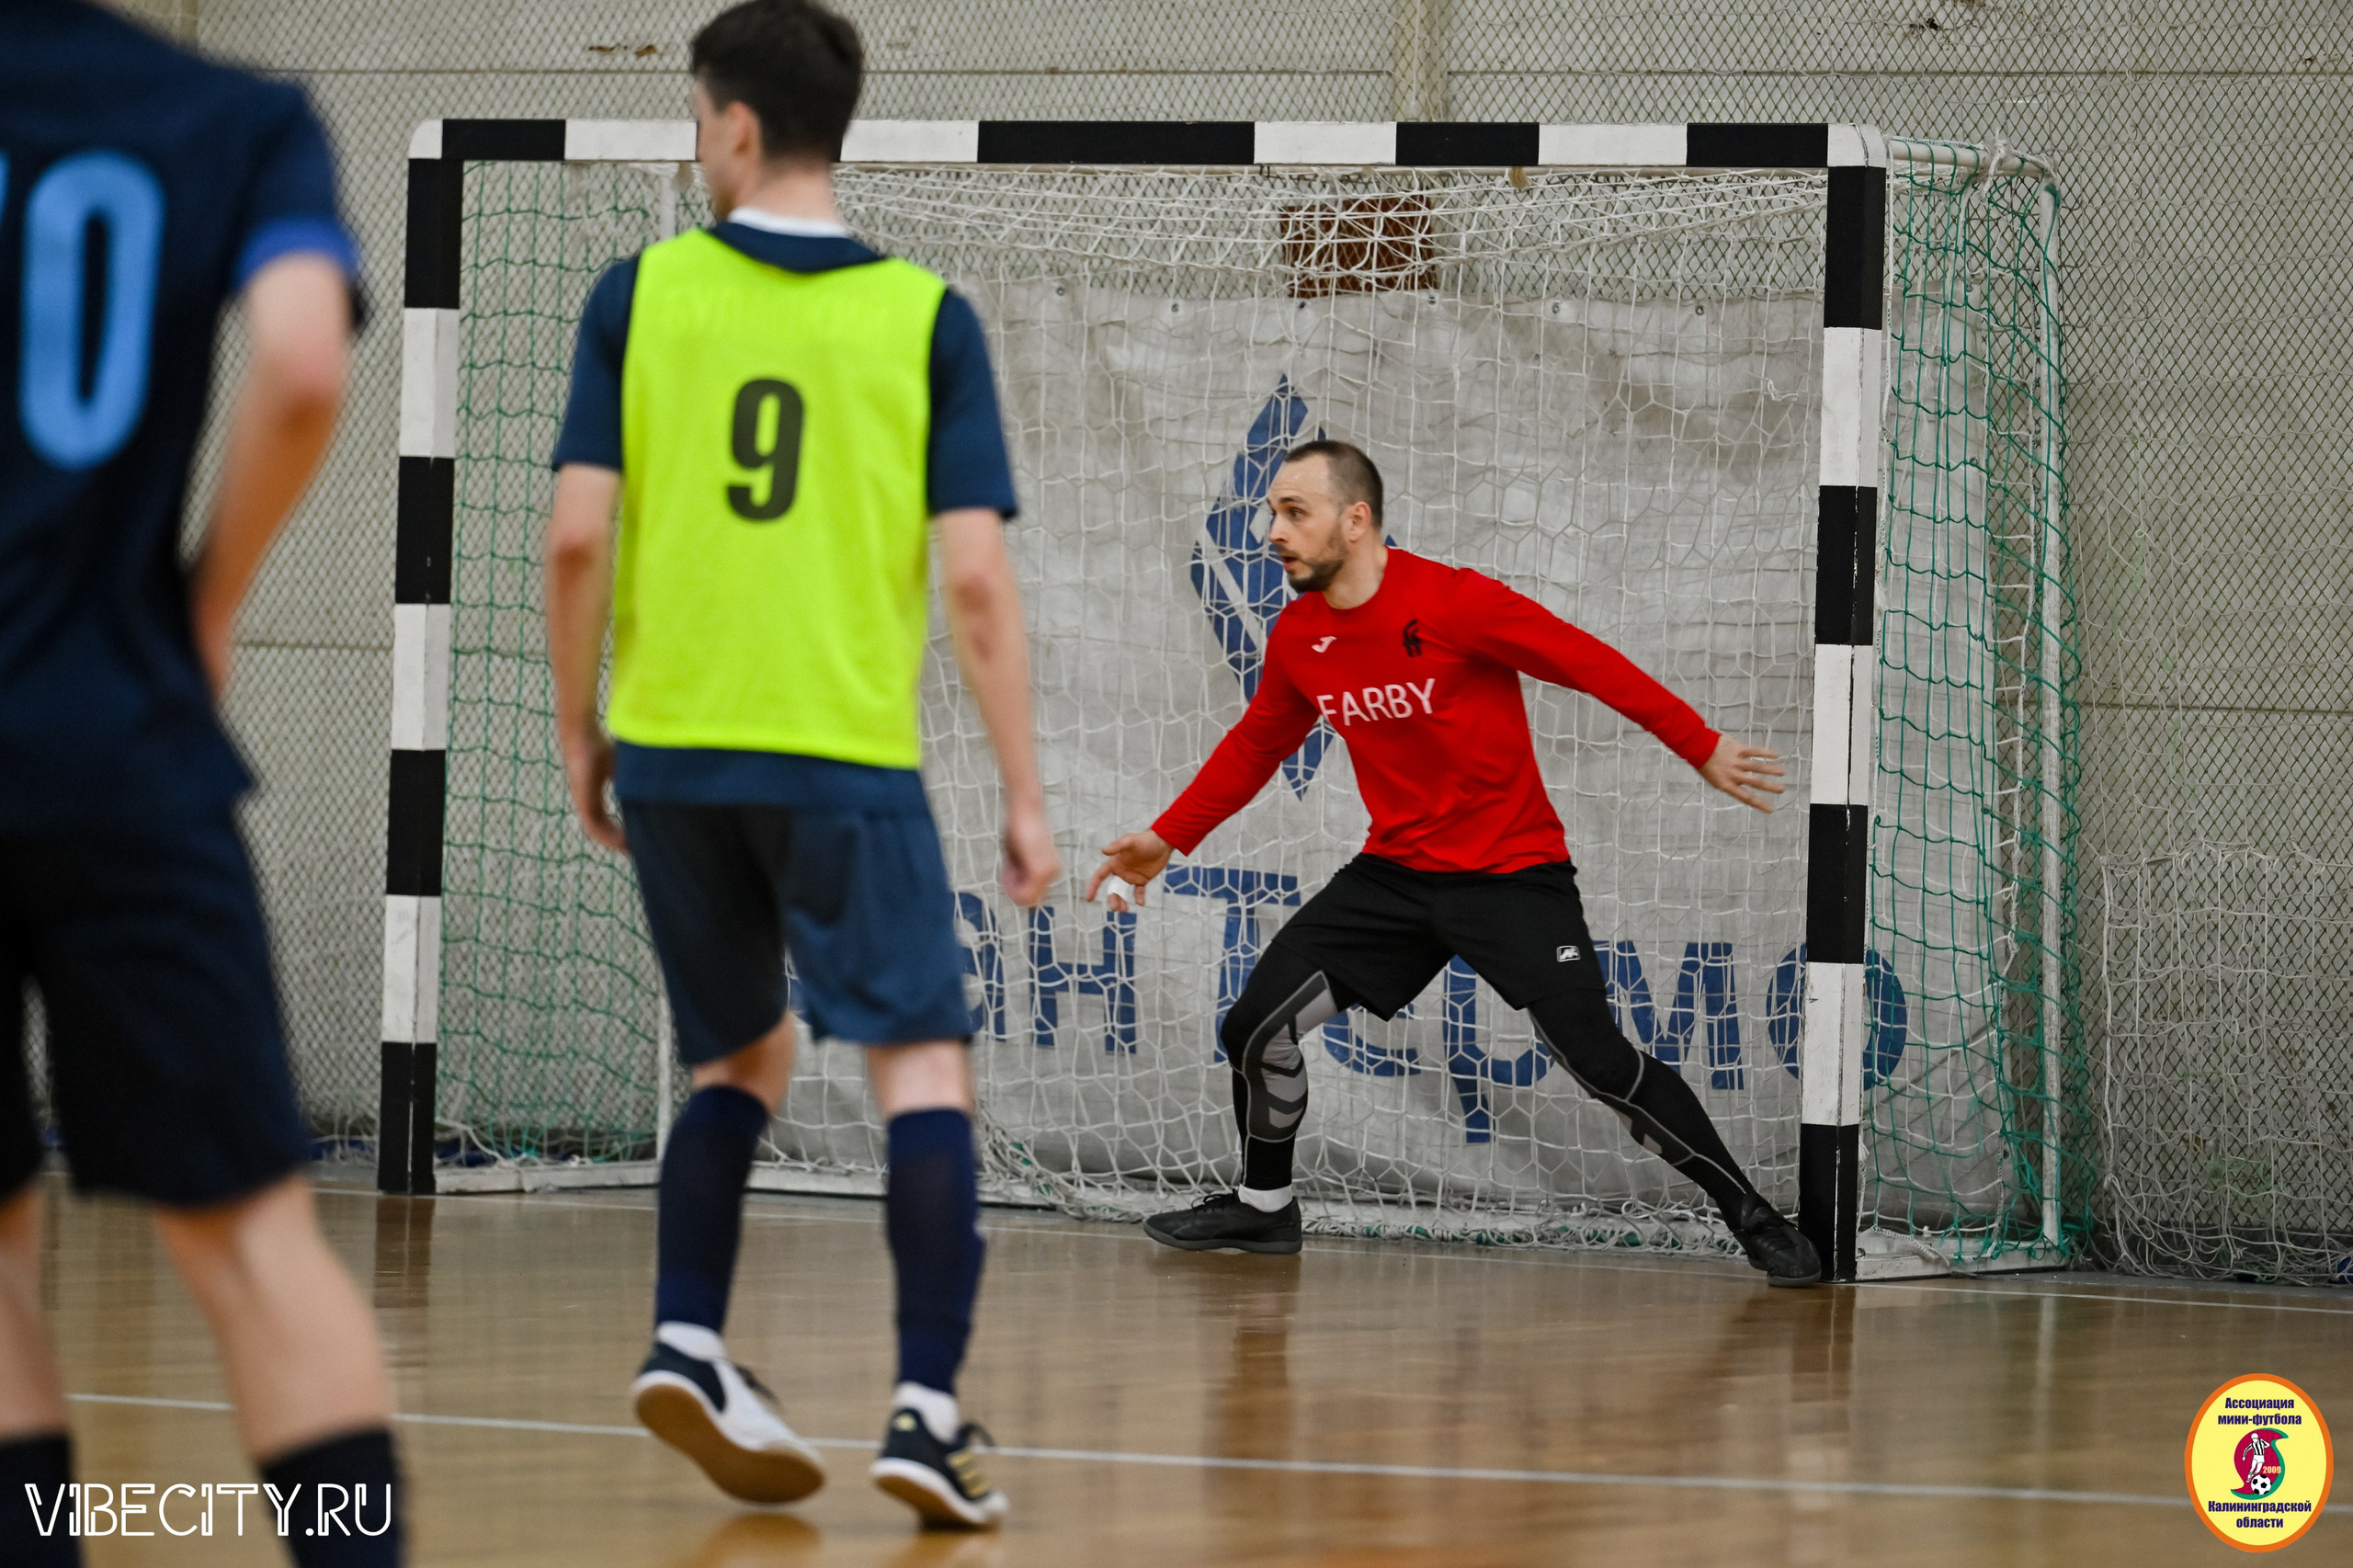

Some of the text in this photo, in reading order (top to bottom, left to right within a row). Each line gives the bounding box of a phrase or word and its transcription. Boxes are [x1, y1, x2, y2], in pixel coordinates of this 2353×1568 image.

[0, 147, 165, 471] 0
[726, 377, 804, 522] 9
[1316, 678, 1436, 726] FARBY
